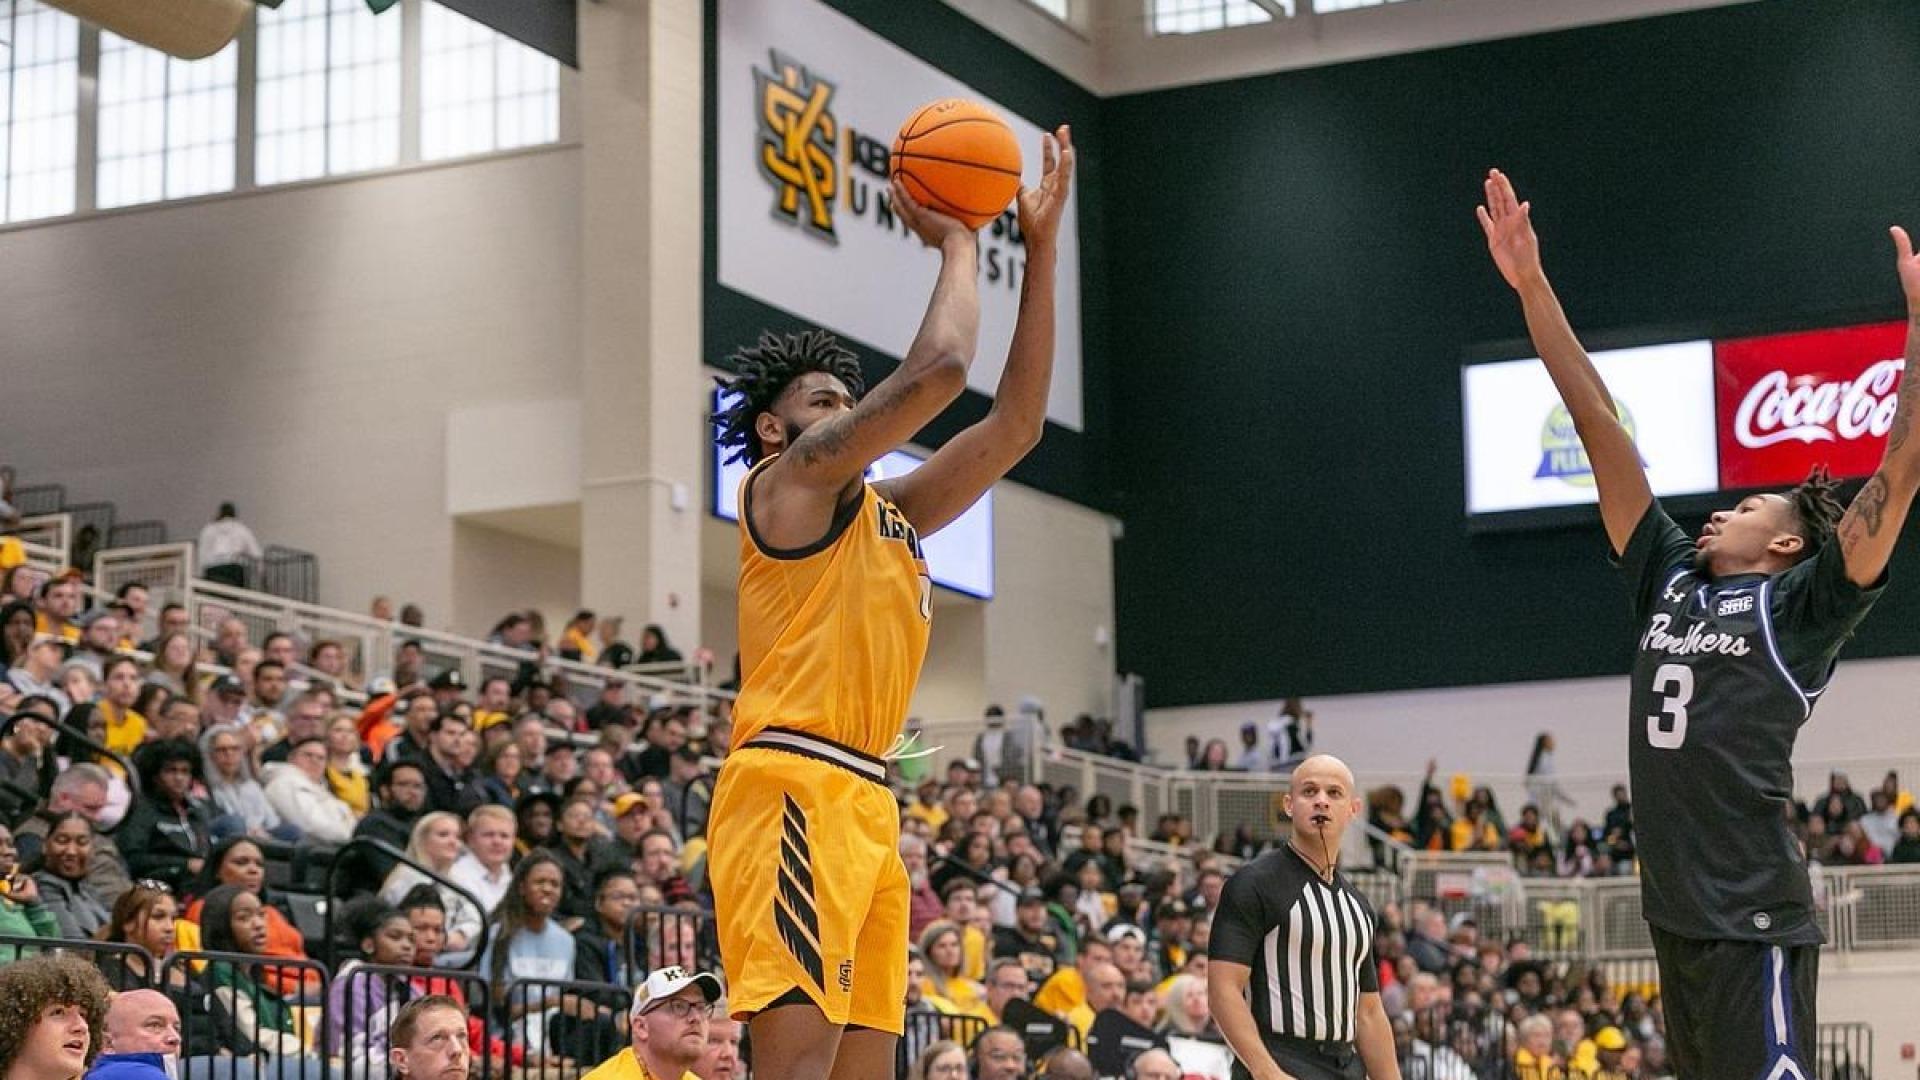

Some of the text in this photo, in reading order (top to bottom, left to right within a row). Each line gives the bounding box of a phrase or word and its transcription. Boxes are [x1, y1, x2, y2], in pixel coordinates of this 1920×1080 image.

[1734, 358, 1905, 448] Coca-Co
[1641, 613, 1750, 656] Panthers
[1647, 664, 1694, 749] 3
